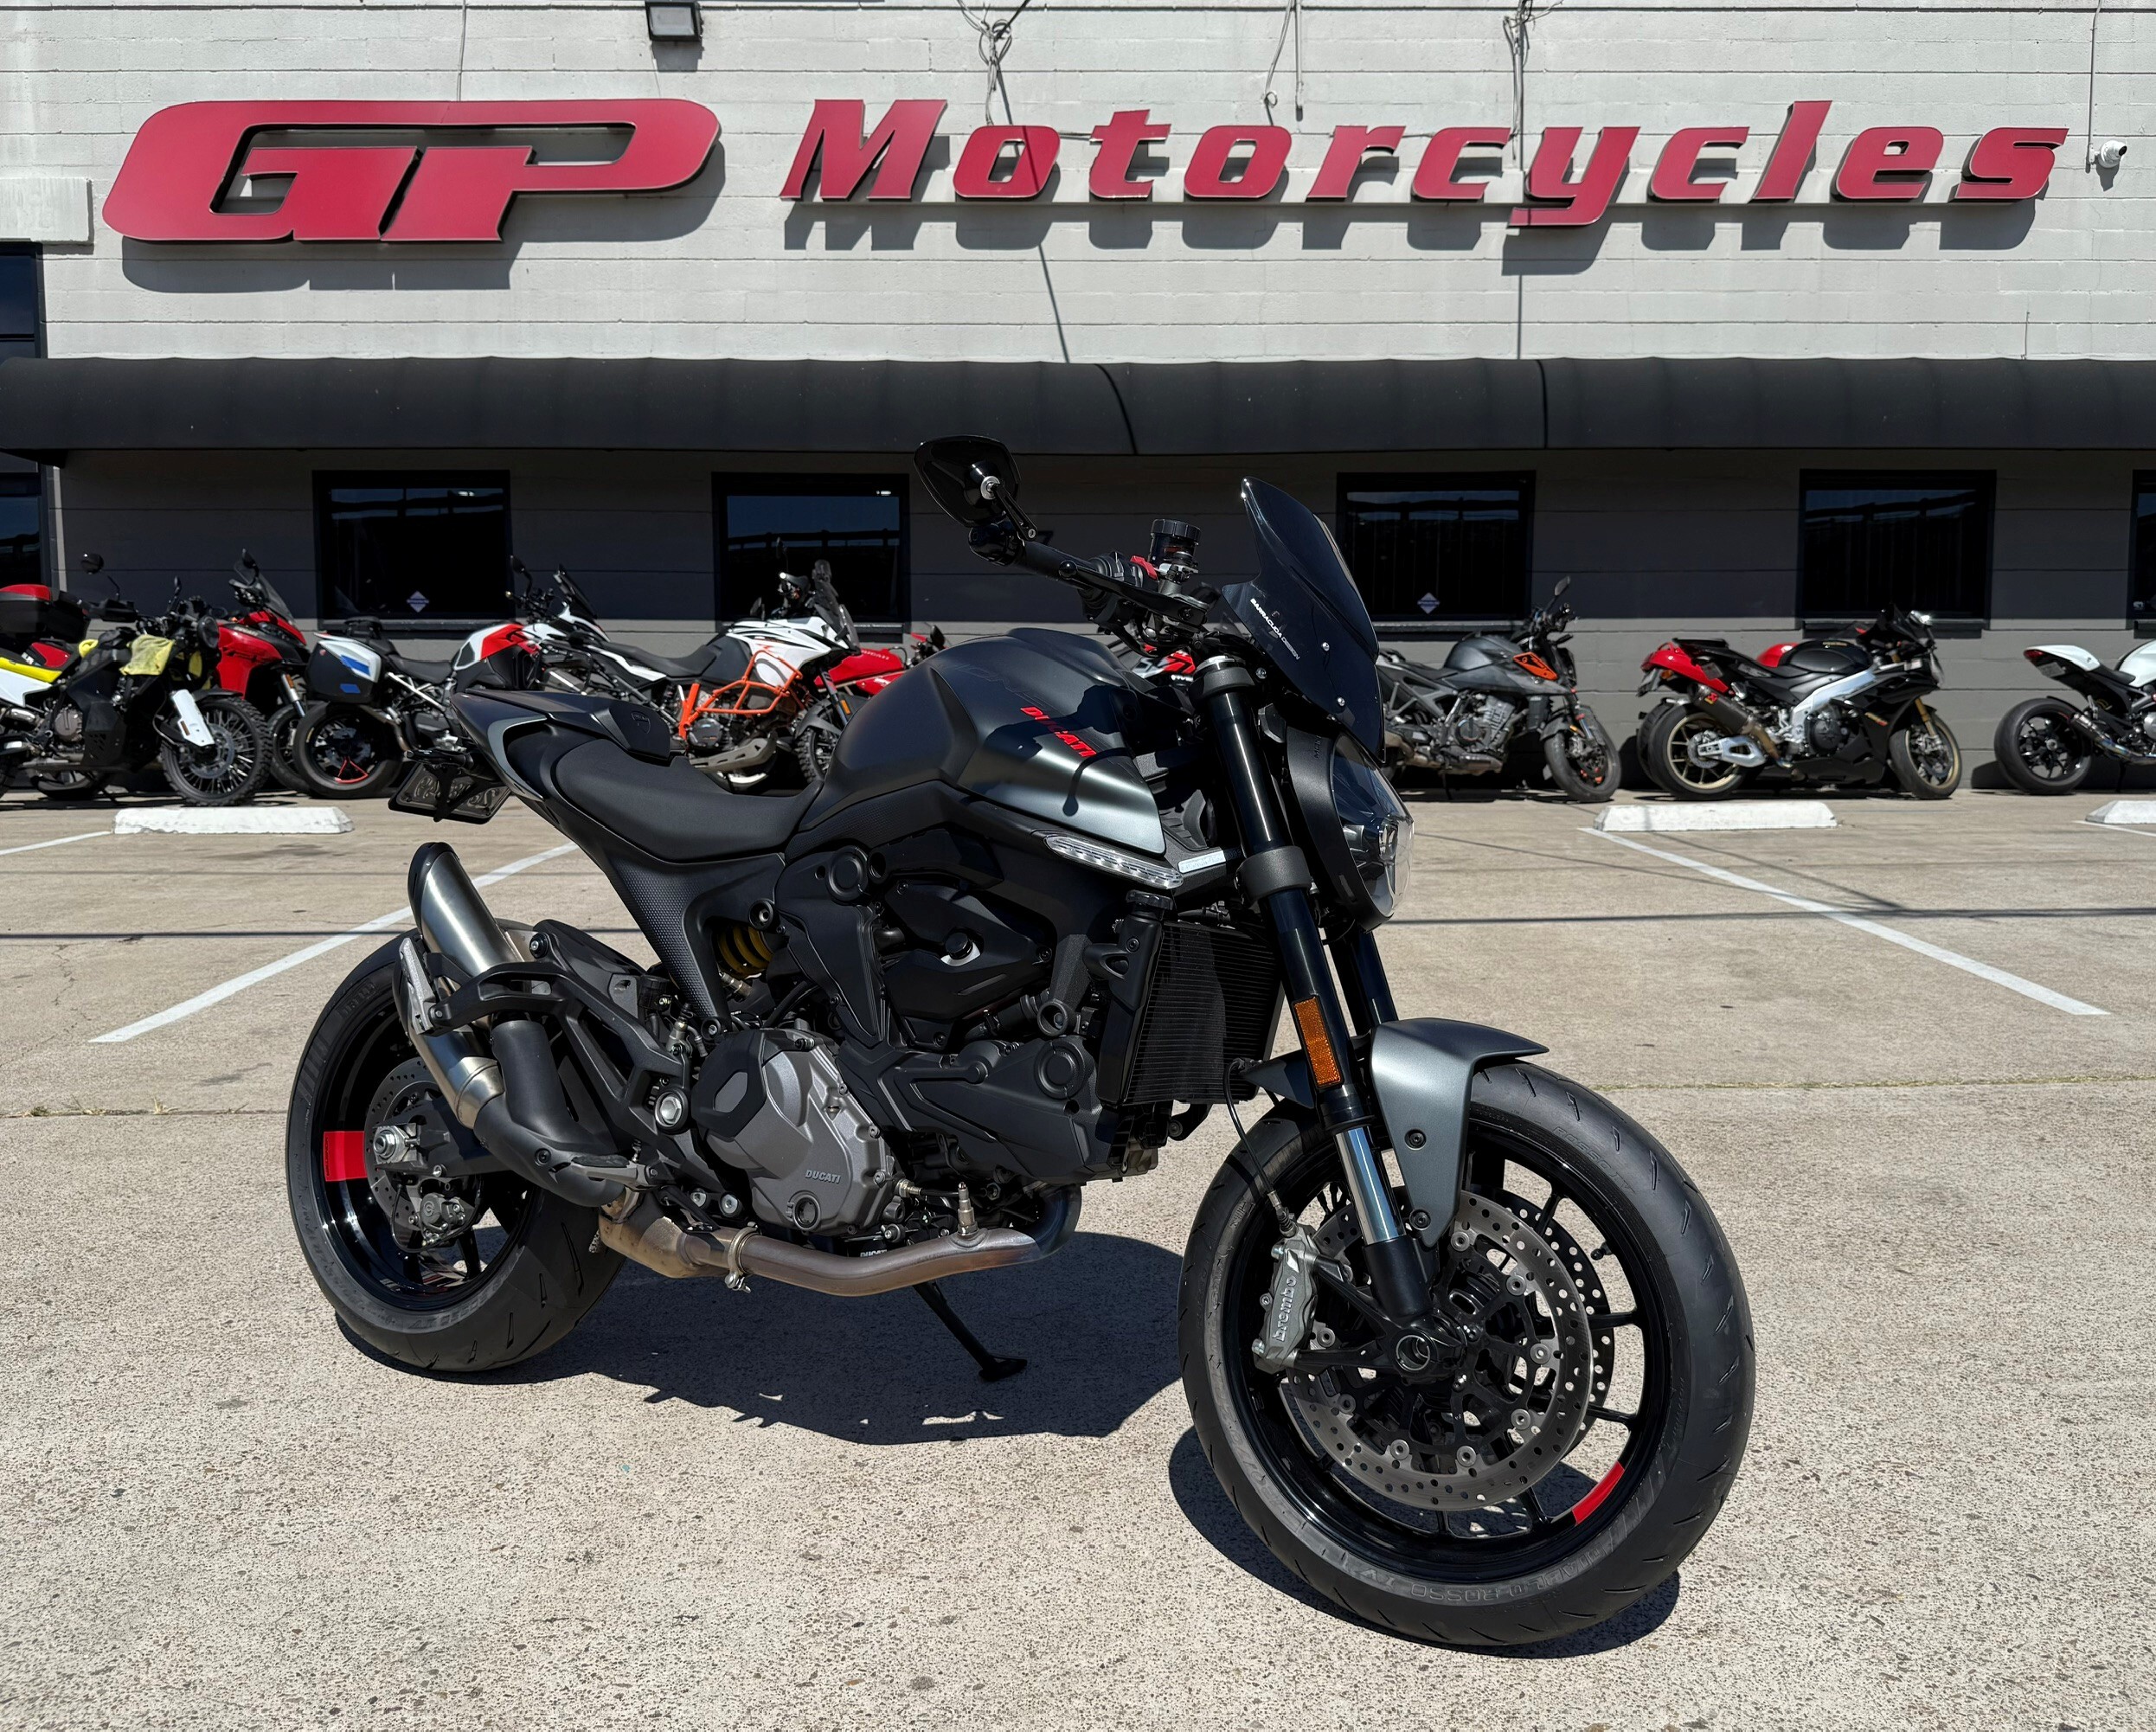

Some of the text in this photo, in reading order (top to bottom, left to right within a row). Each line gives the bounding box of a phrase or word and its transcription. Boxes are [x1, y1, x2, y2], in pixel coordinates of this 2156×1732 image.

[102, 98, 2069, 242] GP Motorcycles
[1250, 598, 1282, 638] BARRACUDA
[1020, 706, 1097, 757] DUCATI
[805, 1170, 841, 1184] DUCATI
[1272, 1275, 1296, 1341] brembo
[1410, 1584, 1499, 1601] ROSSO
